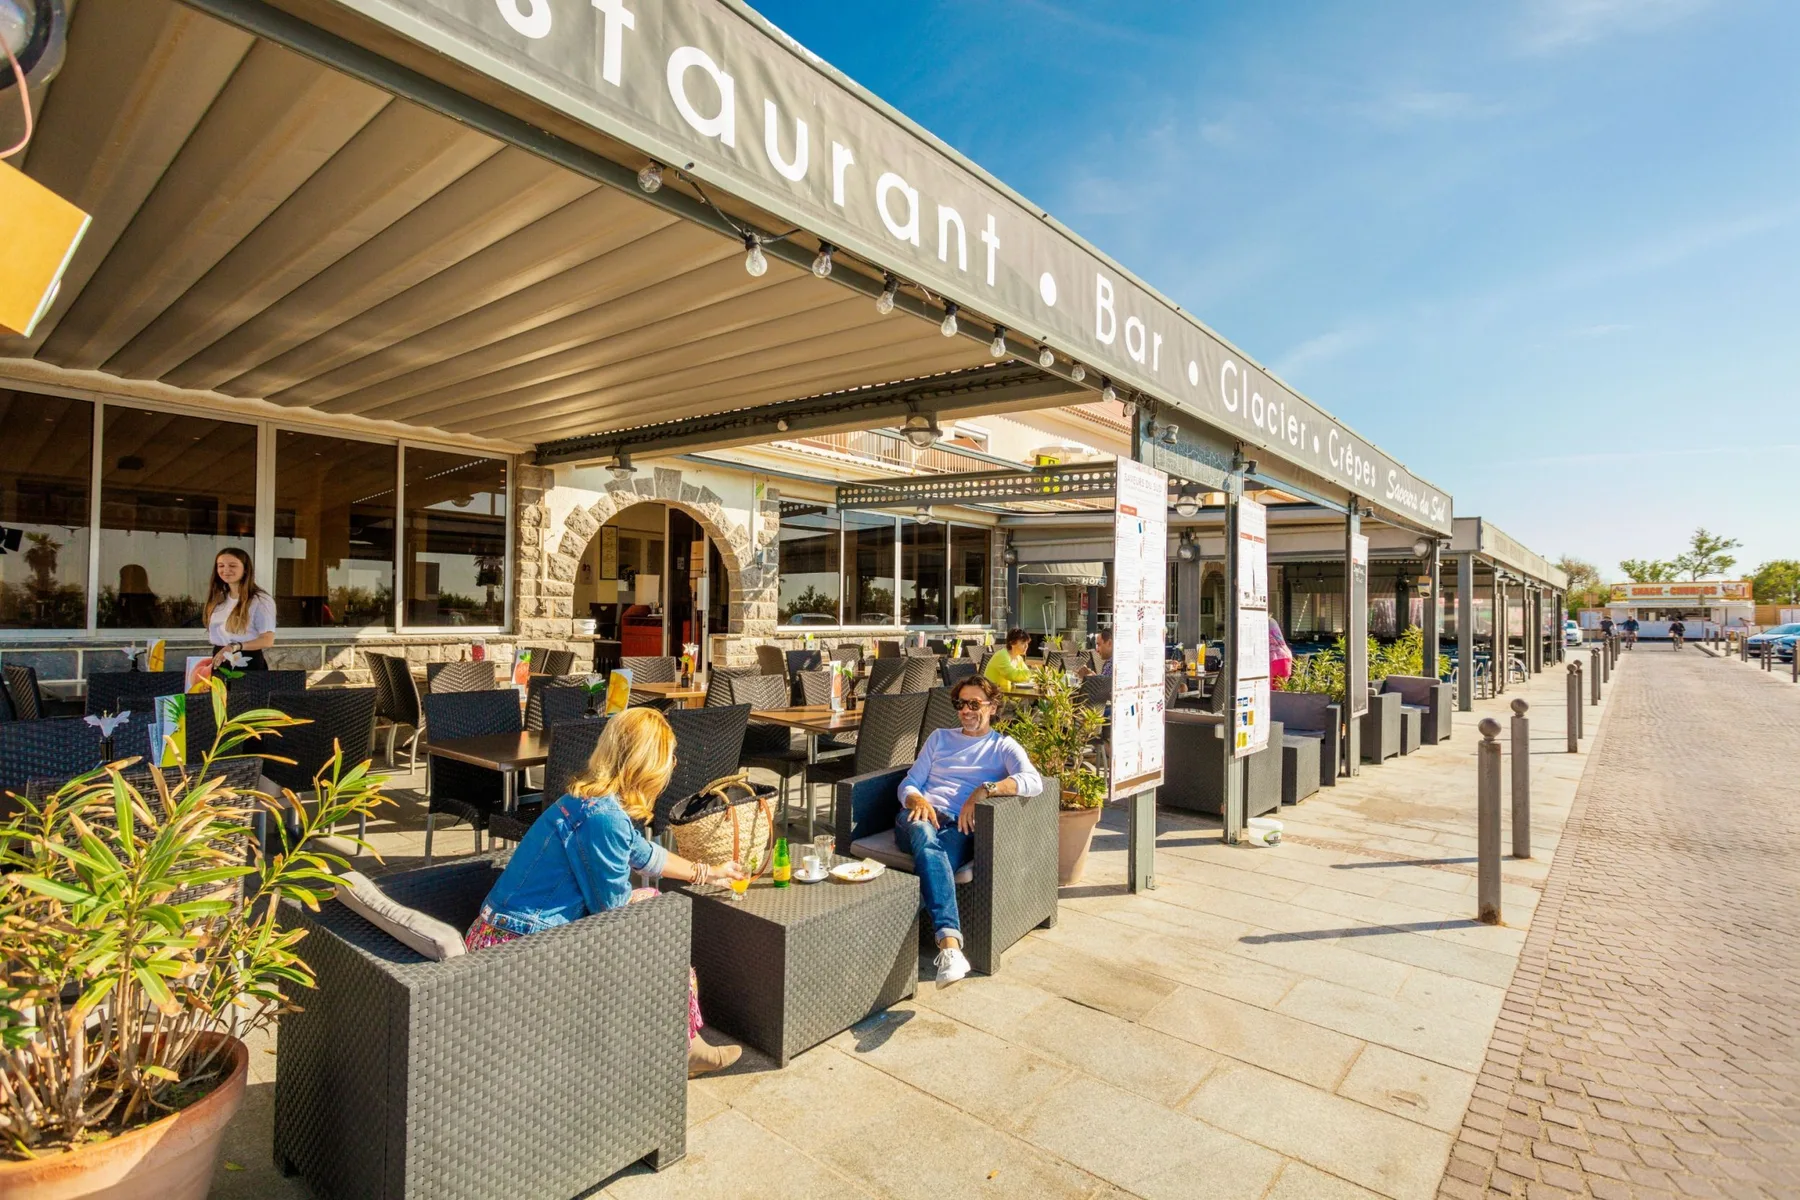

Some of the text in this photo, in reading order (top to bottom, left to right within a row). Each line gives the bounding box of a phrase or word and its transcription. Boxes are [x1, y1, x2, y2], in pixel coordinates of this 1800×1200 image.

[1096, 272, 1163, 372] Bar
[1221, 359, 1306, 450] Glacier
[1328, 428, 1376, 488] Crêpes
